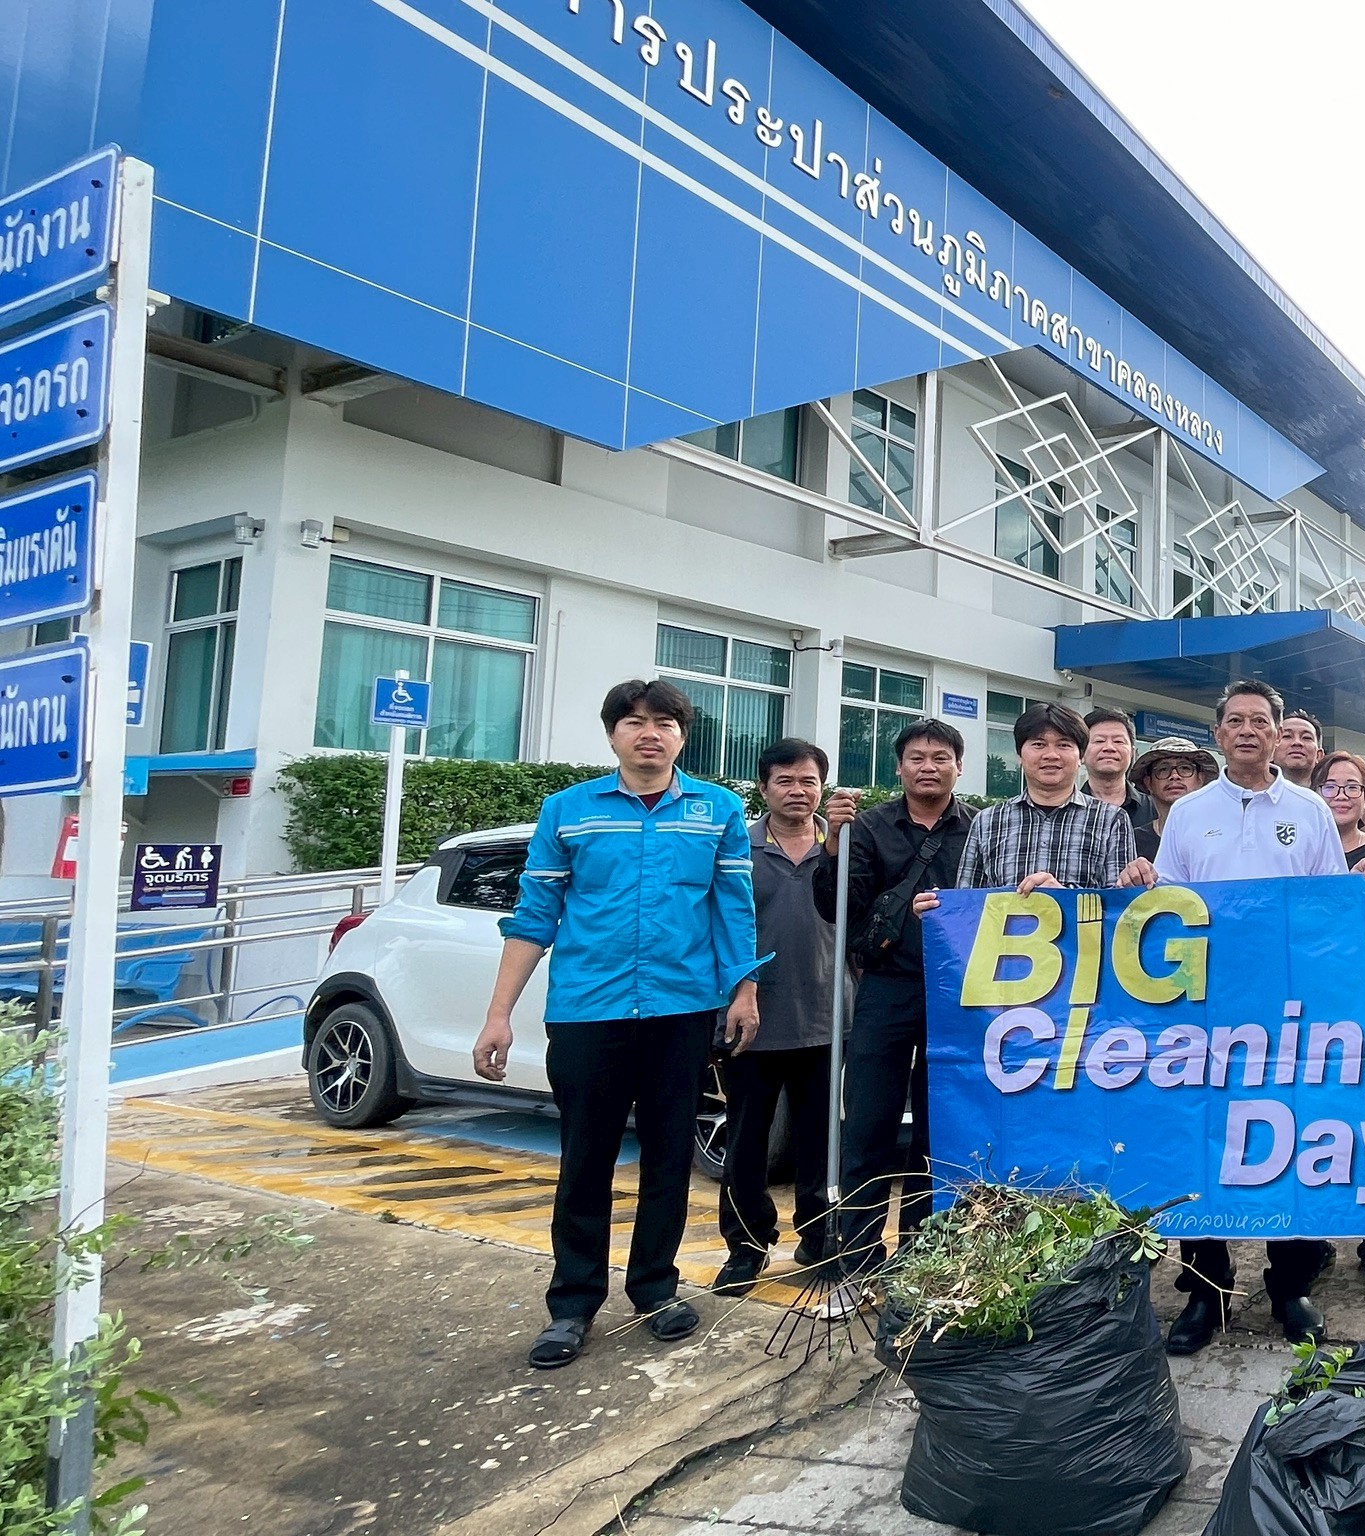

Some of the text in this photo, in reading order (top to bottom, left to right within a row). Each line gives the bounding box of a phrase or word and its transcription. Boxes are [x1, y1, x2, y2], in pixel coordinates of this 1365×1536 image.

[567, 0, 1224, 456] ารประปาส่วนภูมิภาคสาขาคลองหลวง
[960, 886, 1210, 1007] BIG
